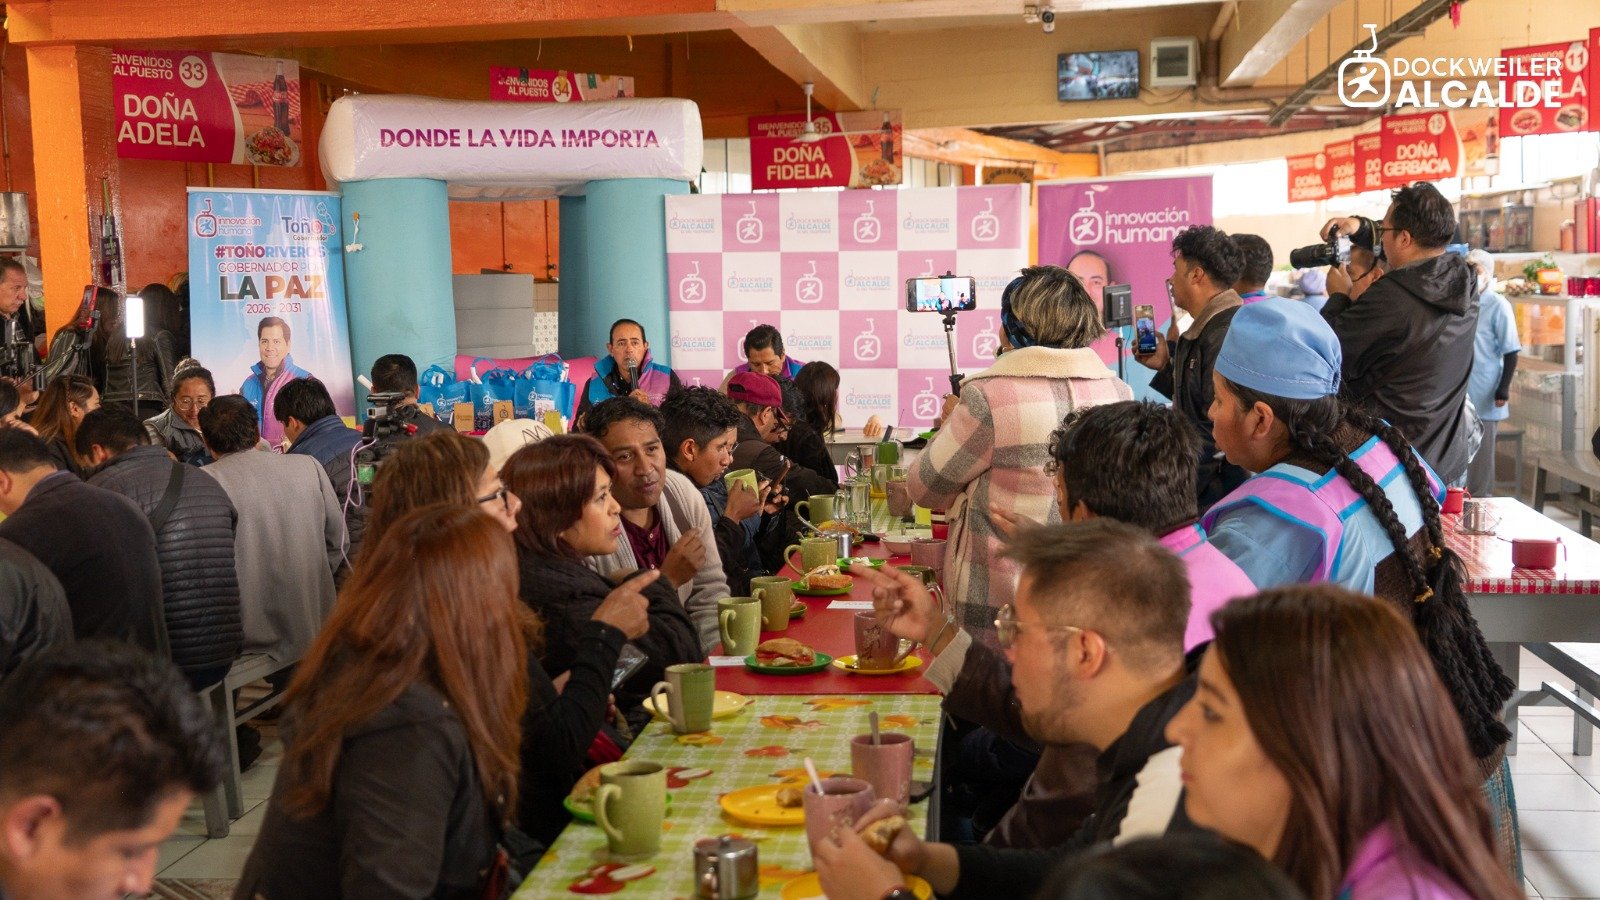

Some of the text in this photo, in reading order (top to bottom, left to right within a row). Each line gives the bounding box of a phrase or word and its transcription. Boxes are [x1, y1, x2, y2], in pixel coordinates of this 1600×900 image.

[1568, 52, 1584, 65] 11
[114, 65, 173, 80] AL PUESTO
[181, 61, 205, 81] 33
[498, 76, 549, 89] ENVNIDOS
[554, 81, 570, 97] 34
[508, 86, 549, 97] AL PUESTO
[124, 92, 198, 122] DOÑA
[757, 121, 807, 131] BIENVENIDO
[776, 129, 803, 138] PUEST
[814, 121, 831, 134] 35
[118, 120, 206, 148] ADELA
[380, 128, 660, 148] DONDE LA VIDA IMPORTA
[773, 144, 825, 163] DOÑA
[1396, 140, 1438, 160] DOÑA
[766, 163, 833, 181] FIDELIA
[1383, 157, 1452, 177] GERBACIA
[217, 215, 261, 226] innovación
[1105, 206, 1189, 226] innovación
[218, 226, 253, 236] humana
[215, 243, 326, 258] #TOÑORIVEROS
[218, 261, 298, 273] GOBERNADOR
[219, 275, 326, 301] LA PAZ
[246, 303, 271, 314] 2026
[279, 302, 302, 313] 2031
